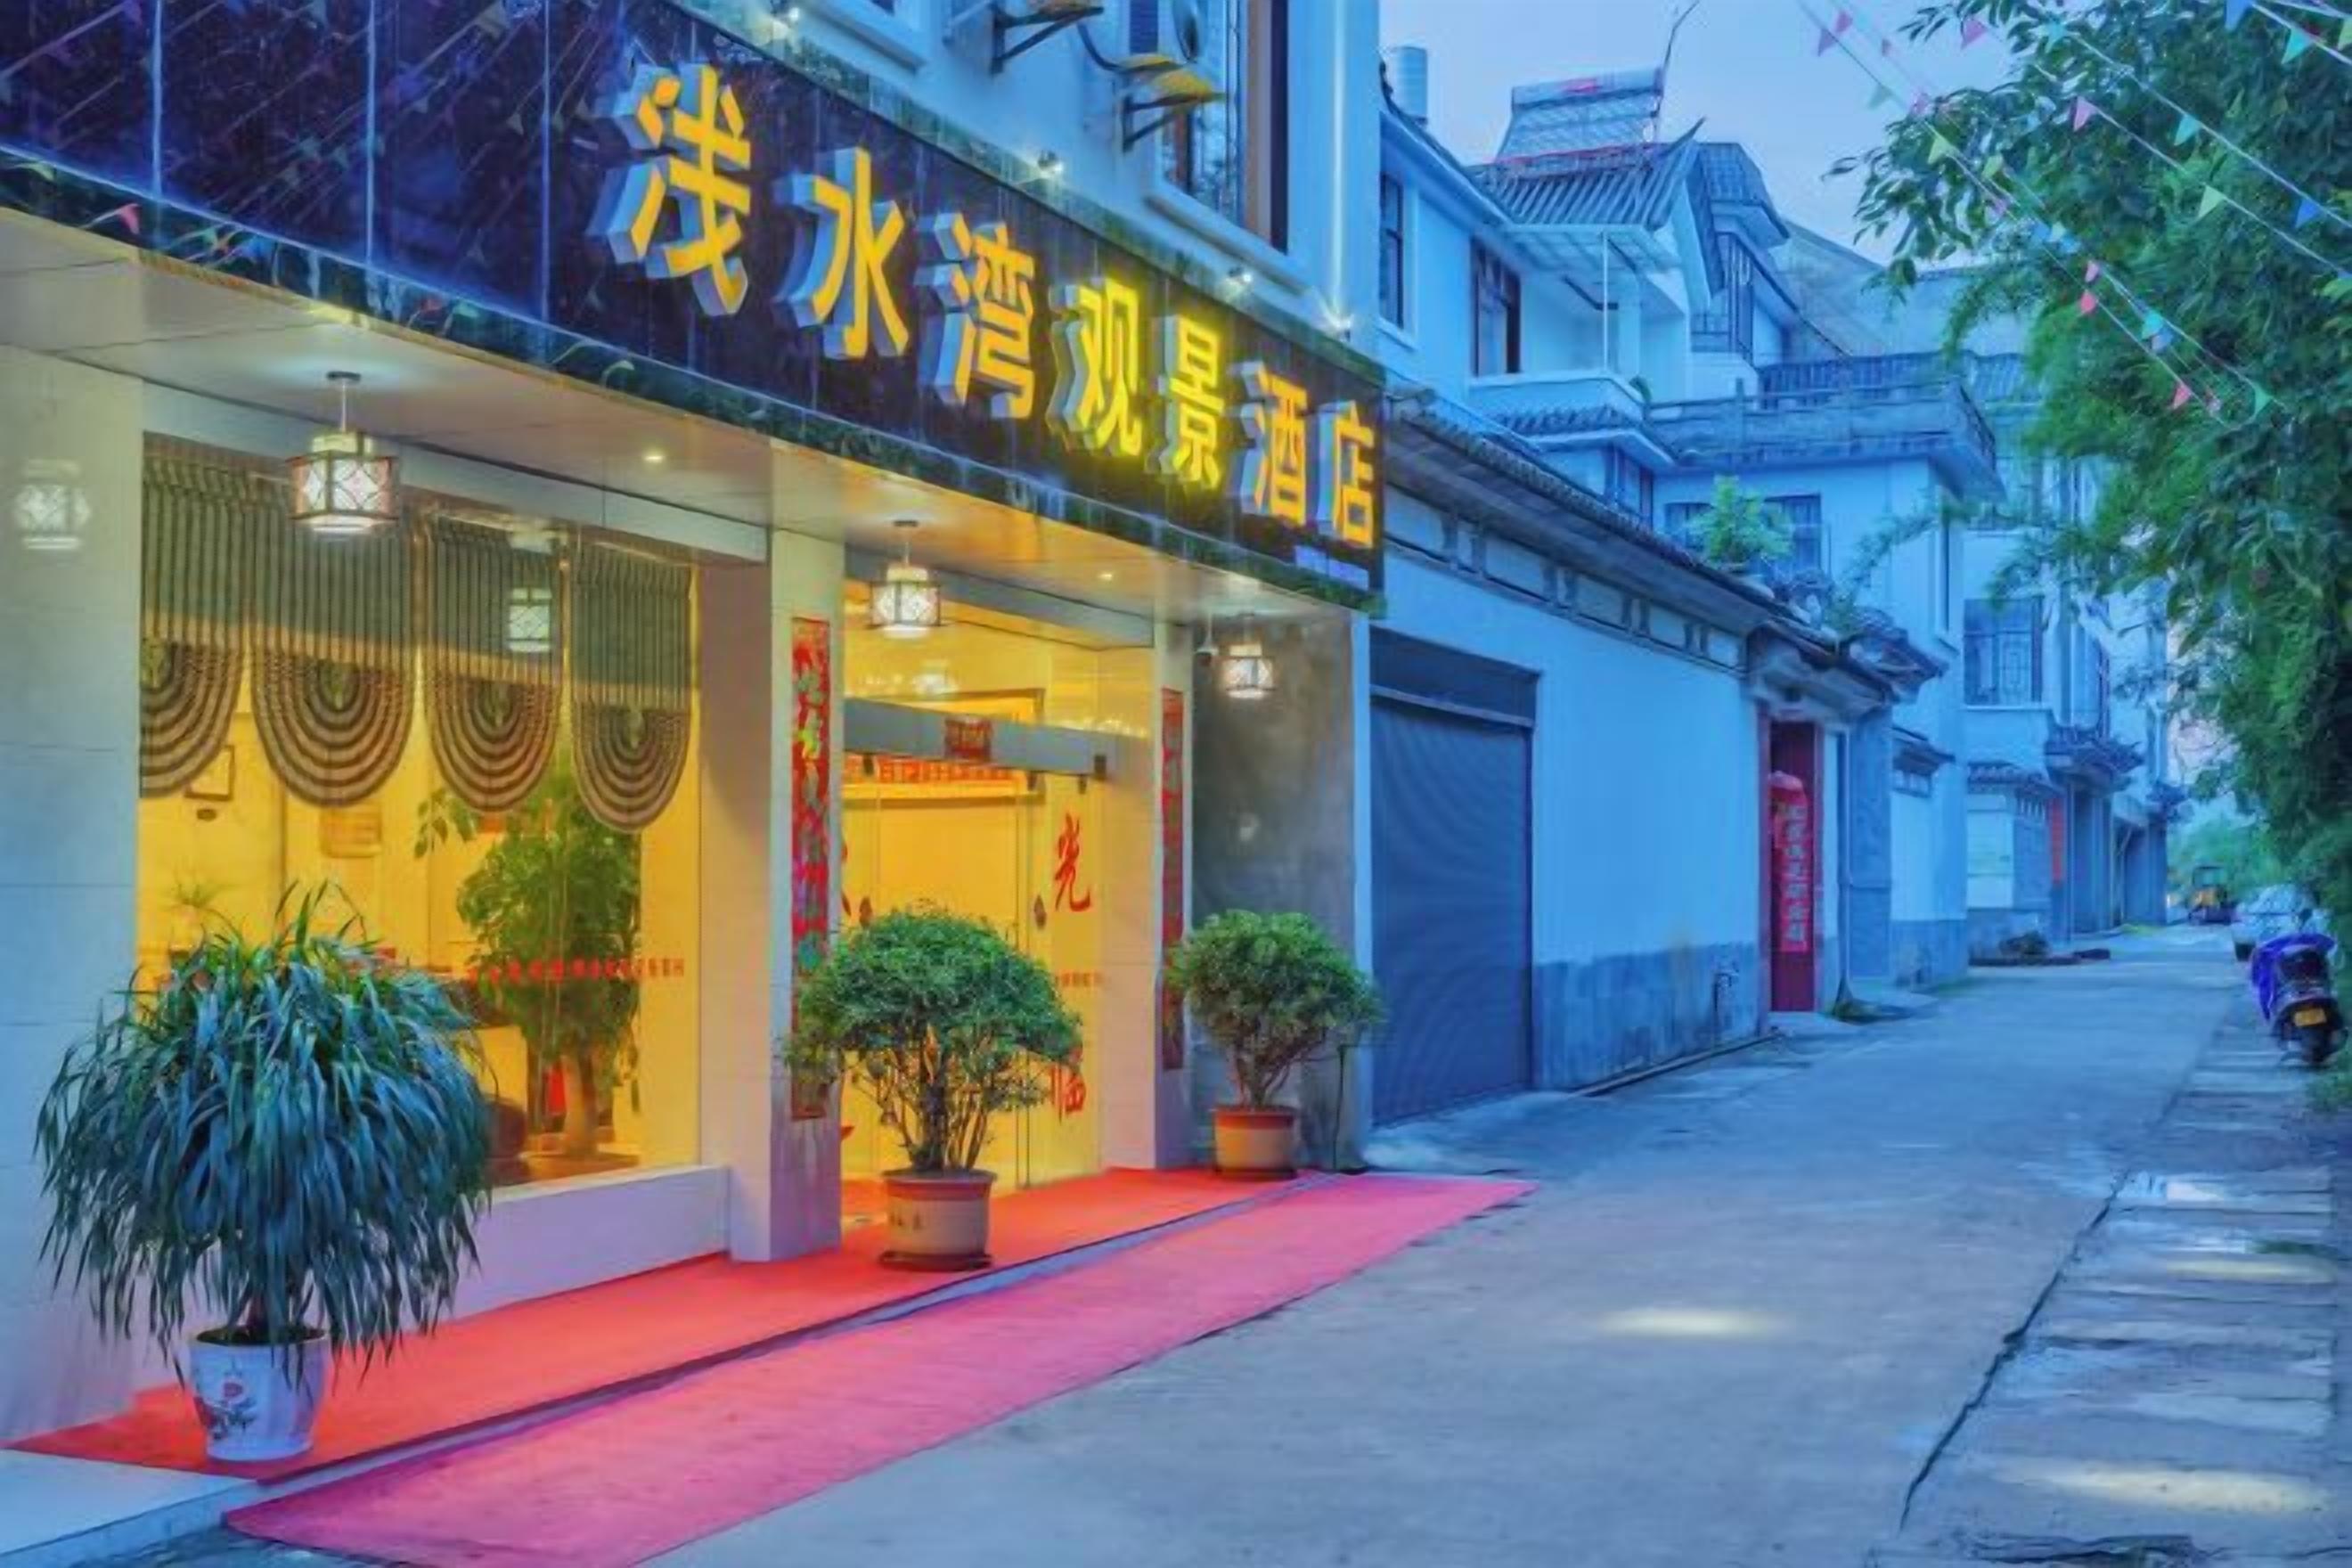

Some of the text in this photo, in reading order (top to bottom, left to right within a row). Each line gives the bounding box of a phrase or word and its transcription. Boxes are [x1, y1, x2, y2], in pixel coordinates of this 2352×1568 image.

[613, 63, 1376, 549] 浅水湾观景酒店
